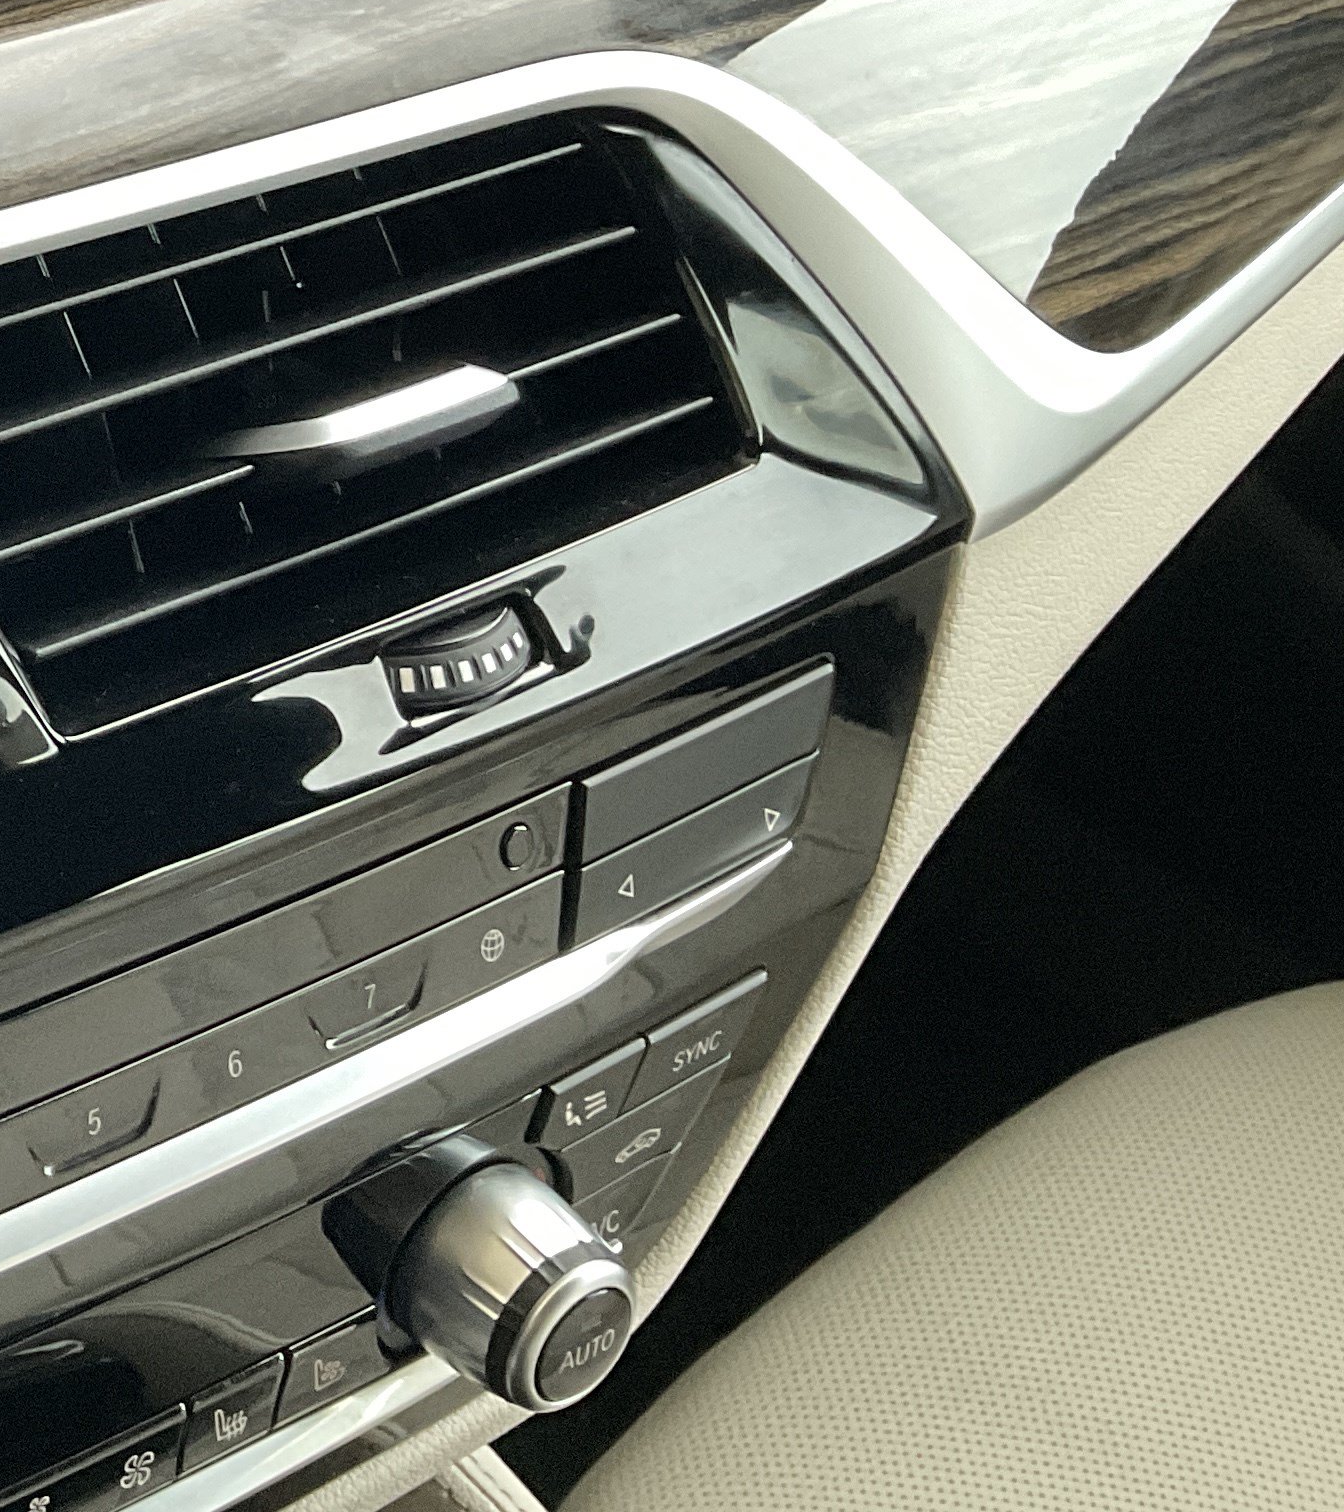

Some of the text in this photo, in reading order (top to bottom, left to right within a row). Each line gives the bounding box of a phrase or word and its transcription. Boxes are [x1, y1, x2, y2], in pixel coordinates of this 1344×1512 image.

[363, 985, 378, 1011] 7
[227, 1050, 243, 1079] 6
[672, 1030, 722, 1072] SYNC
[87, 1108, 102, 1136] 5
[559, 1329, 615, 1372] AUTO
